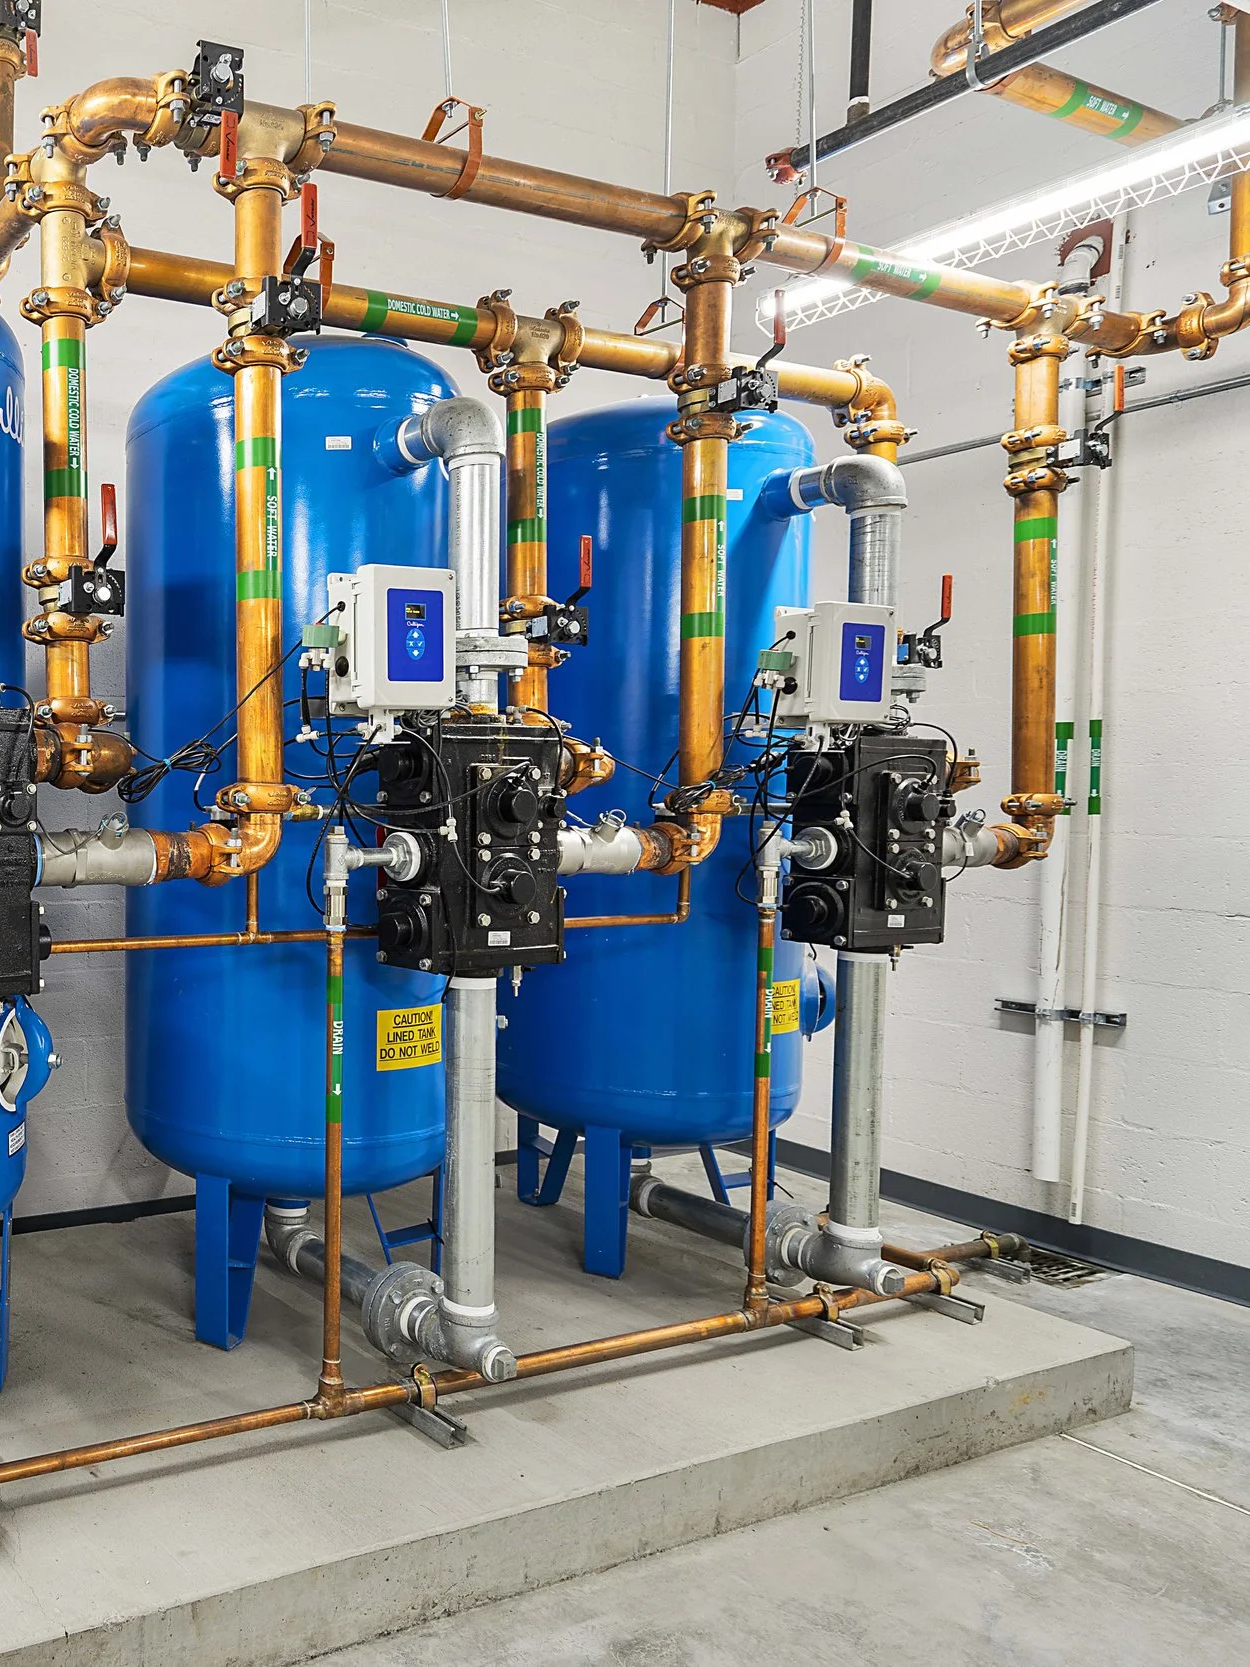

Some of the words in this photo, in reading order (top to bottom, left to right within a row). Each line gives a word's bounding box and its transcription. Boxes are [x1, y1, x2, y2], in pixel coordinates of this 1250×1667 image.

[1086, 95, 1102, 110] SOFT
[1099, 100, 1117, 115] WATER
[877, 261, 892, 273] SOFT
[893, 264, 911, 278] WATER
[387, 299, 416, 314] DOMESTIC
[416, 304, 431, 316] COLD
[431, 306, 451, 320] WATER
[68, 367, 80, 407] DOMESTIC
[68, 407, 80, 429] COLD
[68, 430, 80, 456] WATER
[536, 432, 545, 466] DOMESTIC
[536, 467, 545, 484] COLD
[536, 486, 545, 507] WATER
[266, 495, 278, 521] SOFT
[266, 526, 278, 557] WATER
[717, 544, 726, 564] SOFT
[717, 570, 726, 597] WATER
[1055, 750, 1067, 773] DRAIN
[1091, 748, 1101, 768] DRAIN
[764, 988, 773, 1018] DRAIN
[393, 1010, 434, 1026] CAUTION!
[332, 1020, 344, 1055] DRAIN
[387, 1030, 415, 1043] LINED
[417, 1026, 436, 1040] TANK
[380, 1047, 396, 1059] DO
[399, 1045, 418, 1058] NOT
[420, 1041, 440, 1055] WELD
